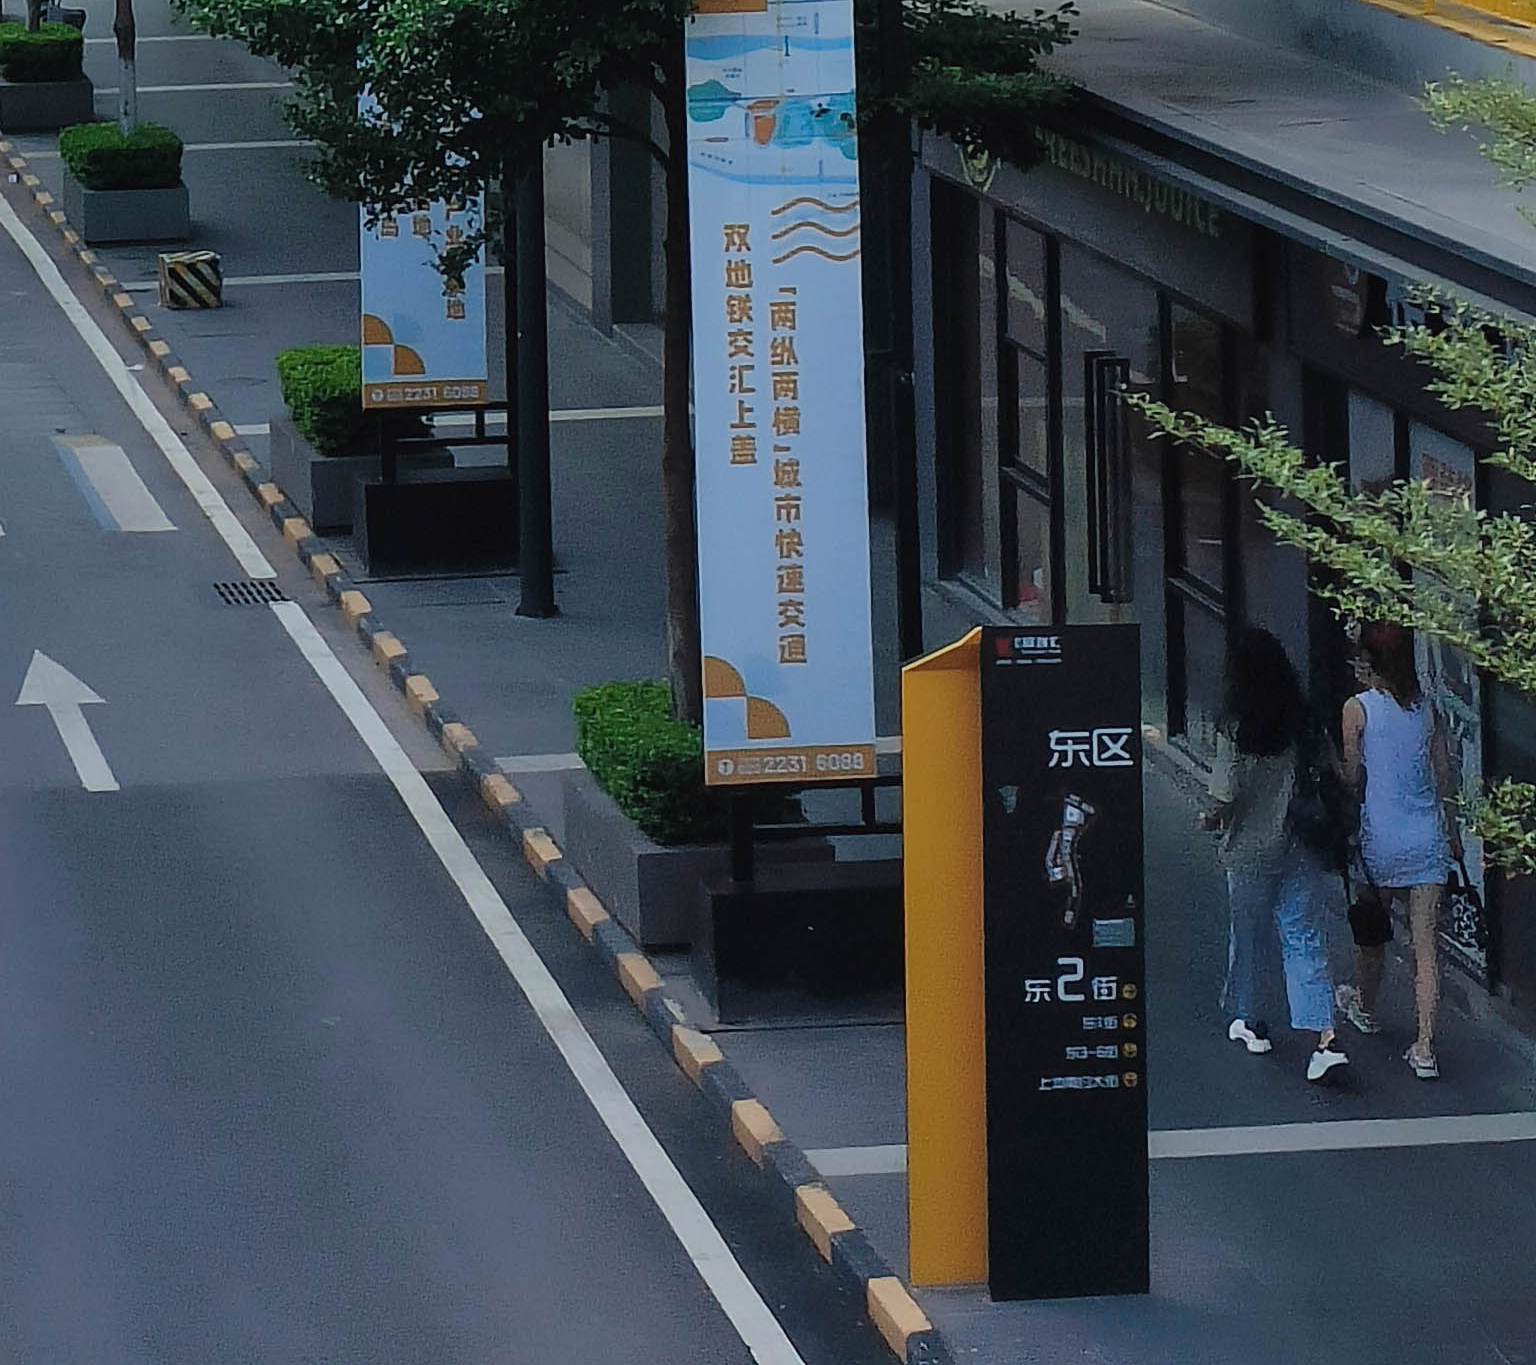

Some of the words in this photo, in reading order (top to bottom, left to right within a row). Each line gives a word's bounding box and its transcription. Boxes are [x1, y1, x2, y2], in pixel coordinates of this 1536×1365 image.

[723, 224, 757, 465] 双地铁交汇上盖
[1048, 727, 1134, 767] 东区
